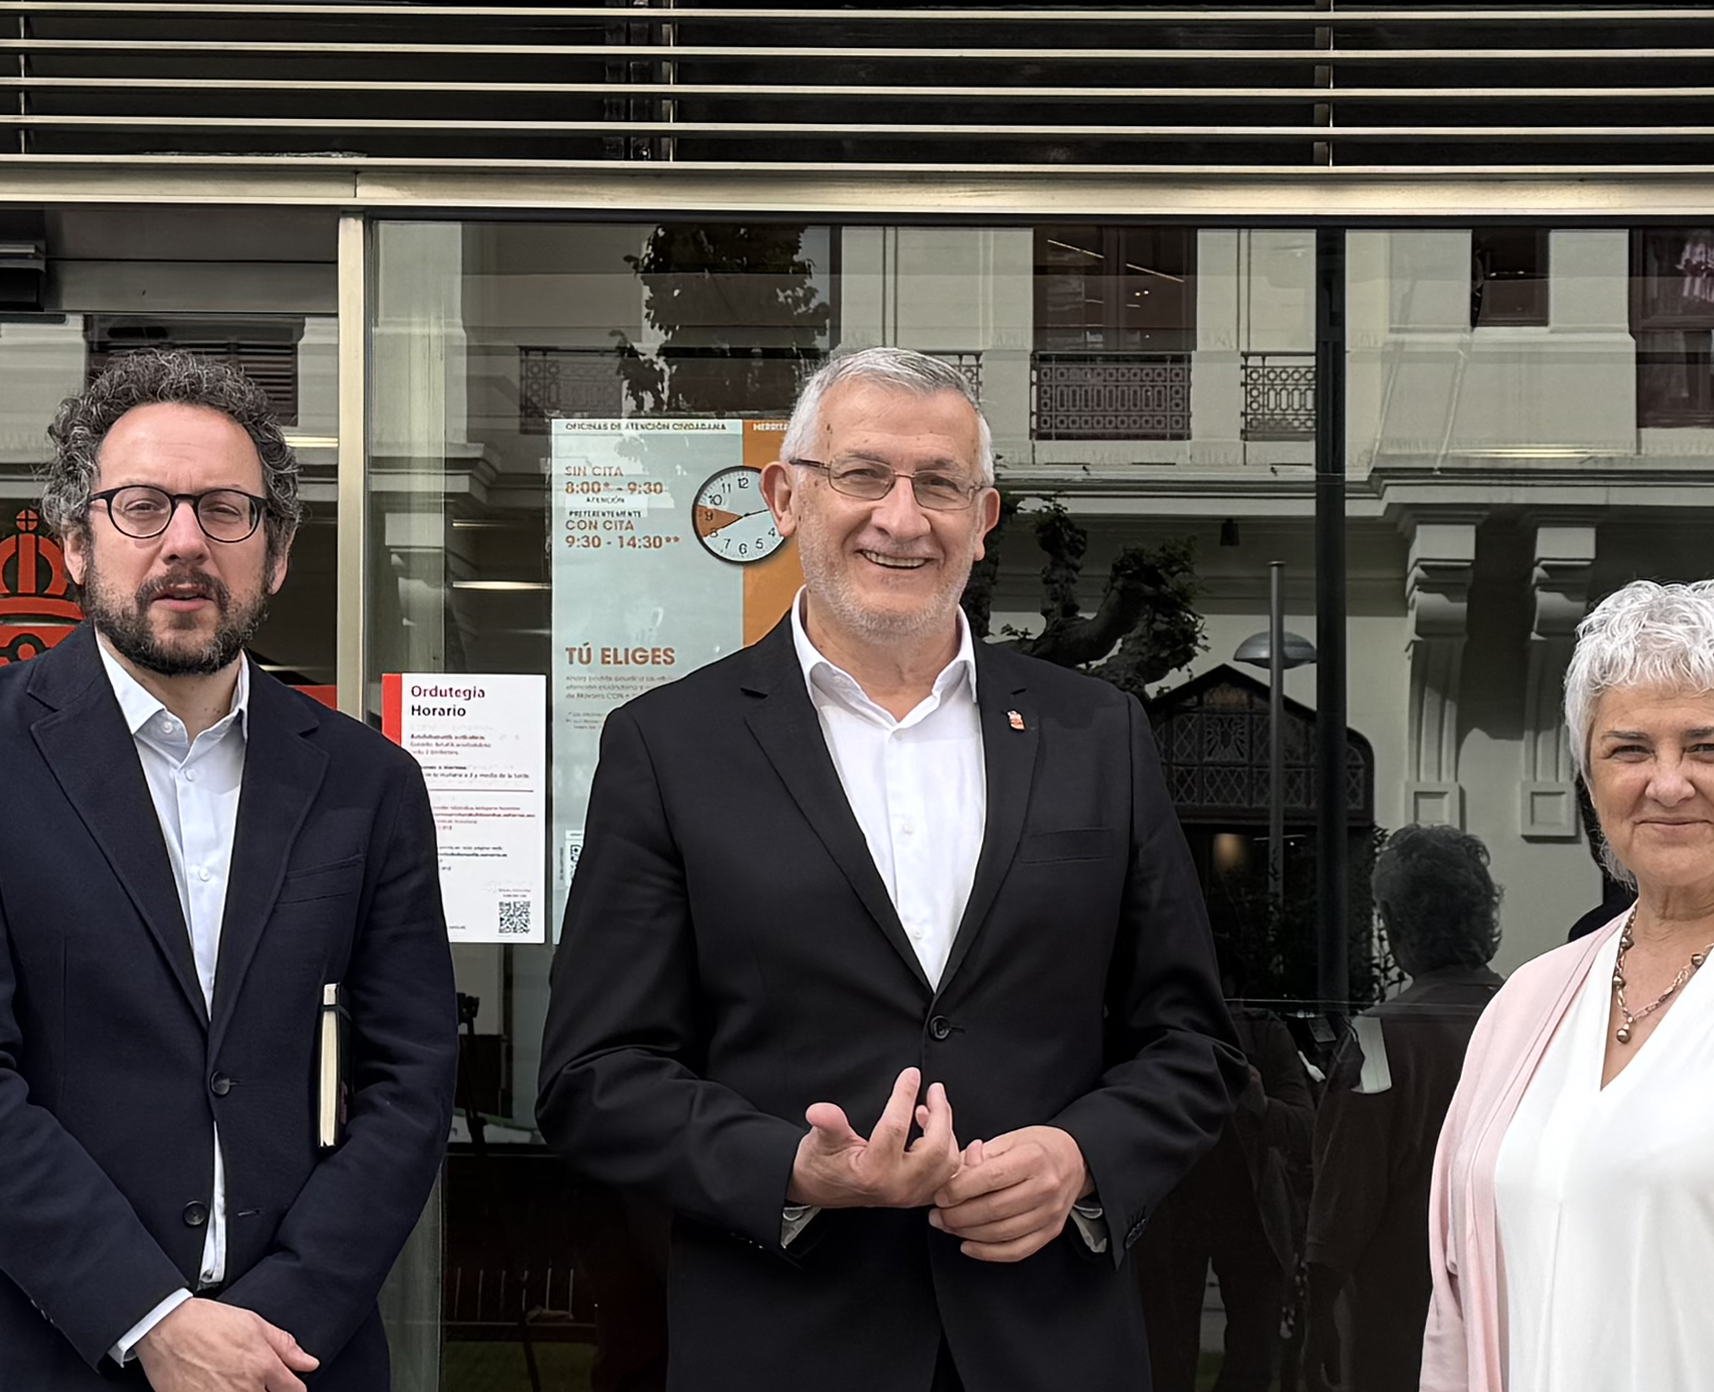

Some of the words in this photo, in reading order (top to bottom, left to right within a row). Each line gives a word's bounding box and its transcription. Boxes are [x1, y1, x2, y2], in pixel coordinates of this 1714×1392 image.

[565, 466, 587, 477] SIN
[592, 466, 624, 477] CITA
[627, 481, 664, 495] 9:30
[722, 483, 731, 494] 11
[566, 520, 597, 530] CON
[603, 520, 634, 531] CITA
[566, 535, 601, 548] 9:30
[724, 538, 732, 549] 7
[755, 538, 764, 549] 5
[738, 543, 748, 555] 6
[566, 642, 591, 665] TÚ
[601, 647, 675, 665] ELIGES
[411, 686, 485, 701] Ordutegia
[412, 705, 466, 716] Horario
